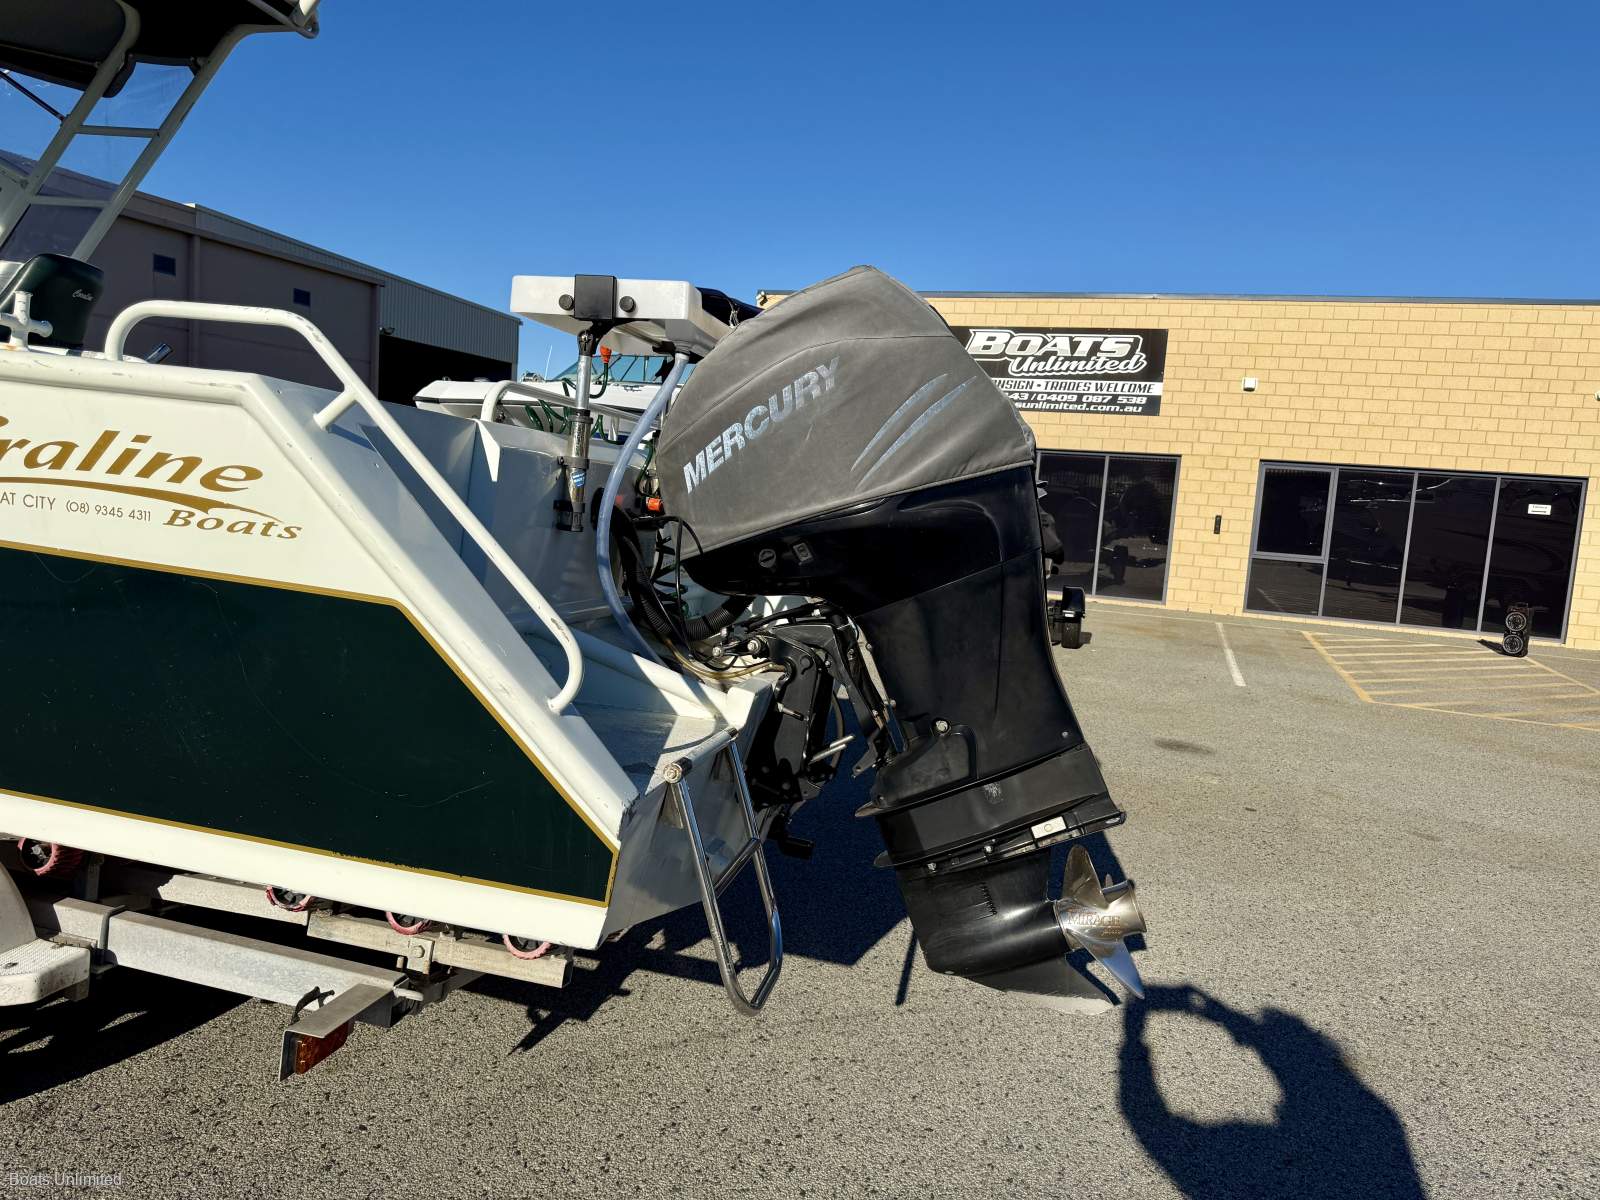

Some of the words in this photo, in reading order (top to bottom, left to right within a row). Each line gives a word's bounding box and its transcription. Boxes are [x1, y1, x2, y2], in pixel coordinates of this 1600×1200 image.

[966, 330, 1135, 358] BOATS
[1010, 354, 1146, 374] Unlimited
[1005, 392, 1078, 402] 43/0409
[1081, 394, 1113, 403] 087
[1116, 395, 1148, 404] 538
[1044, 380, 1092, 392] TRADES
[1095, 382, 1155, 394] WELCOME
[683, 356, 840, 494] MERCURY
[0, 416, 263, 492] raline
[23, 494, 56, 510] CITY
[66, 500, 90, 514] (08)
[94, 504, 124, 518] 9345
[128, 509, 151, 522] 4311
[163, 509, 302, 539] Boats
